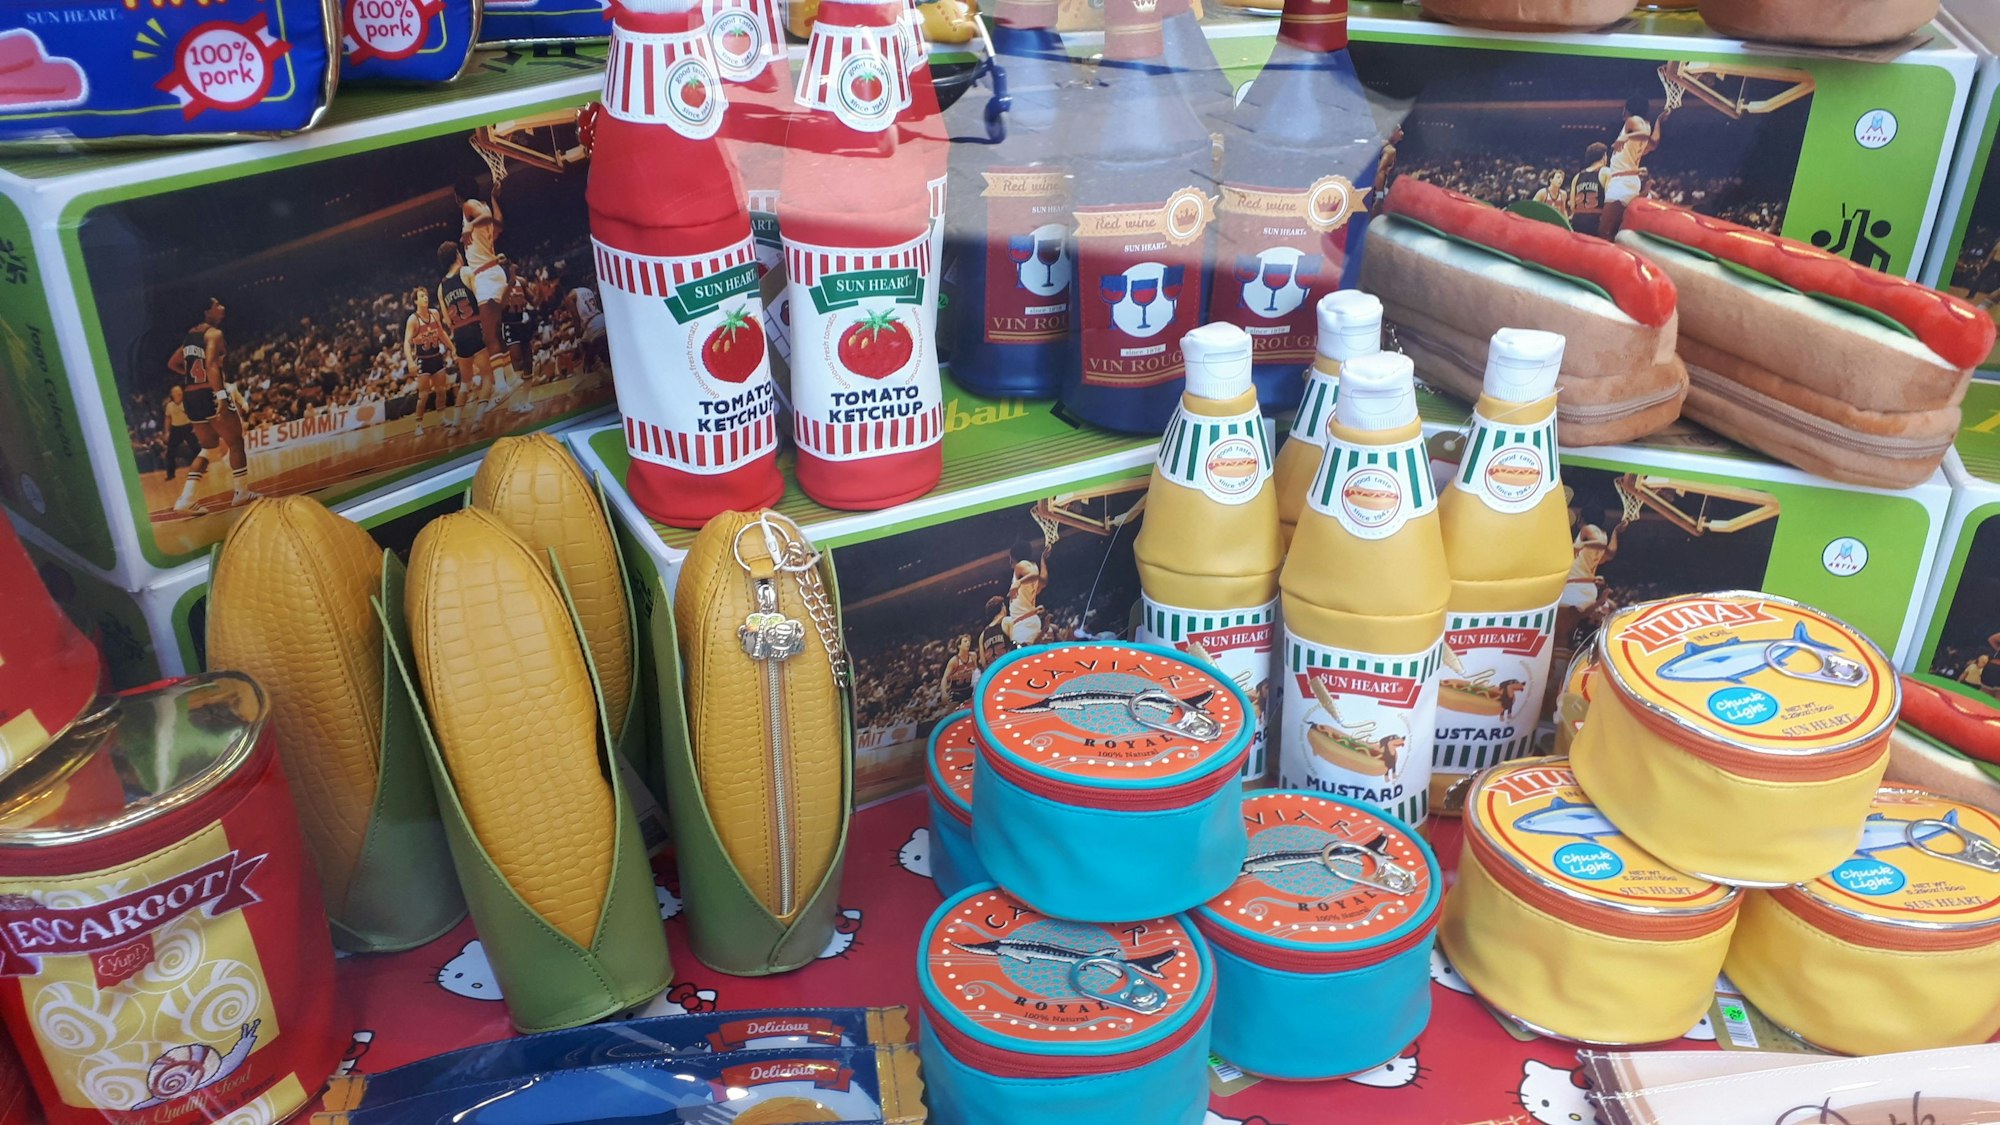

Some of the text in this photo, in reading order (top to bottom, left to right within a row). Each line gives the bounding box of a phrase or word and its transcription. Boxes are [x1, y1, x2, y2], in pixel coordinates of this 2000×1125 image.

[26, 8, 118, 25] SUN HEART
[357, 0, 414, 19] 100%
[365, 19, 413, 42] pork
[189, 42, 255, 66] 100%
[199, 64, 255, 93] pork
[1003, 181, 1026, 193] Red
[1032, 206, 1046, 214] SUN
[1238, 195, 1297, 213] Red wine
[1096, 216, 1157, 230] Red wine
[1264, 227, 1305, 237] SUN HEART
[1124, 242, 1166, 253] SUN HEART
[695, 267, 756, 299] SUN HEART
[836, 274, 910, 293] SUN HEART
[992, 316, 1028, 330] VIN
[686, 321, 700, 350] tomato
[1089, 350, 1183, 372] VIN ROUG
[694, 370, 720, 400] delicious
[700, 380, 772, 415] TOMATO
[831, 385, 919, 407] TOMATO
[698, 396, 774, 434] KETCHUP
[829, 401, 924, 424] KETCHUP
[945, 398, 1030, 433] ball
[243, 410, 348, 449] HE SUMMIT
[1640, 604, 1744, 640] TUNA
[1202, 628, 1270, 648] SUN HEART
[1448, 632, 1524, 644] SUN HEART
[1693, 630, 1733, 642] IN OIL
[1027, 660, 1182, 690] CAVIAR
[1320, 672, 1400, 693] SUN HEART
[1715, 692, 1766, 712] Chunk
[1727, 704, 1768, 722] Light
[1434, 726, 1515, 740] USTARD
[1782, 712, 1853, 738] SUN HEART
[857, 730, 886, 749] MIT
[1083, 734, 1173, 749] ROYAL
[1096, 748, 1159, 759] 100% Natural
[1306, 775, 1404, 803] MUSTARD
[1518, 770, 1578, 789] TU
[1244, 808, 1354, 837] VIAR
[1562, 850, 1614, 866] Chunk
[1570, 862, 1612, 876] Light
[1840, 866, 1894, 882] Chunk
[1620, 886, 1692, 896] SUN HEART
[1849, 876, 1894, 890] Light
[8, 870, 225, 947] ESCARGOT
[1297, 890, 1378, 912] ROYAL
[1904, 896, 1983, 910] SUN HEART
[1315, 913, 1340, 922] 100%
[109, 946, 140, 972] Yup!
[1014, 996, 1110, 1015] ROYAL
[1024, 1012, 1089, 1023] 100% Natural
[746, 1021, 810, 1035] Delicious
[750, 1064, 816, 1080] Delicious
[154, 1094, 209, 1124] Quality
[215, 1064, 252, 1095] Food
